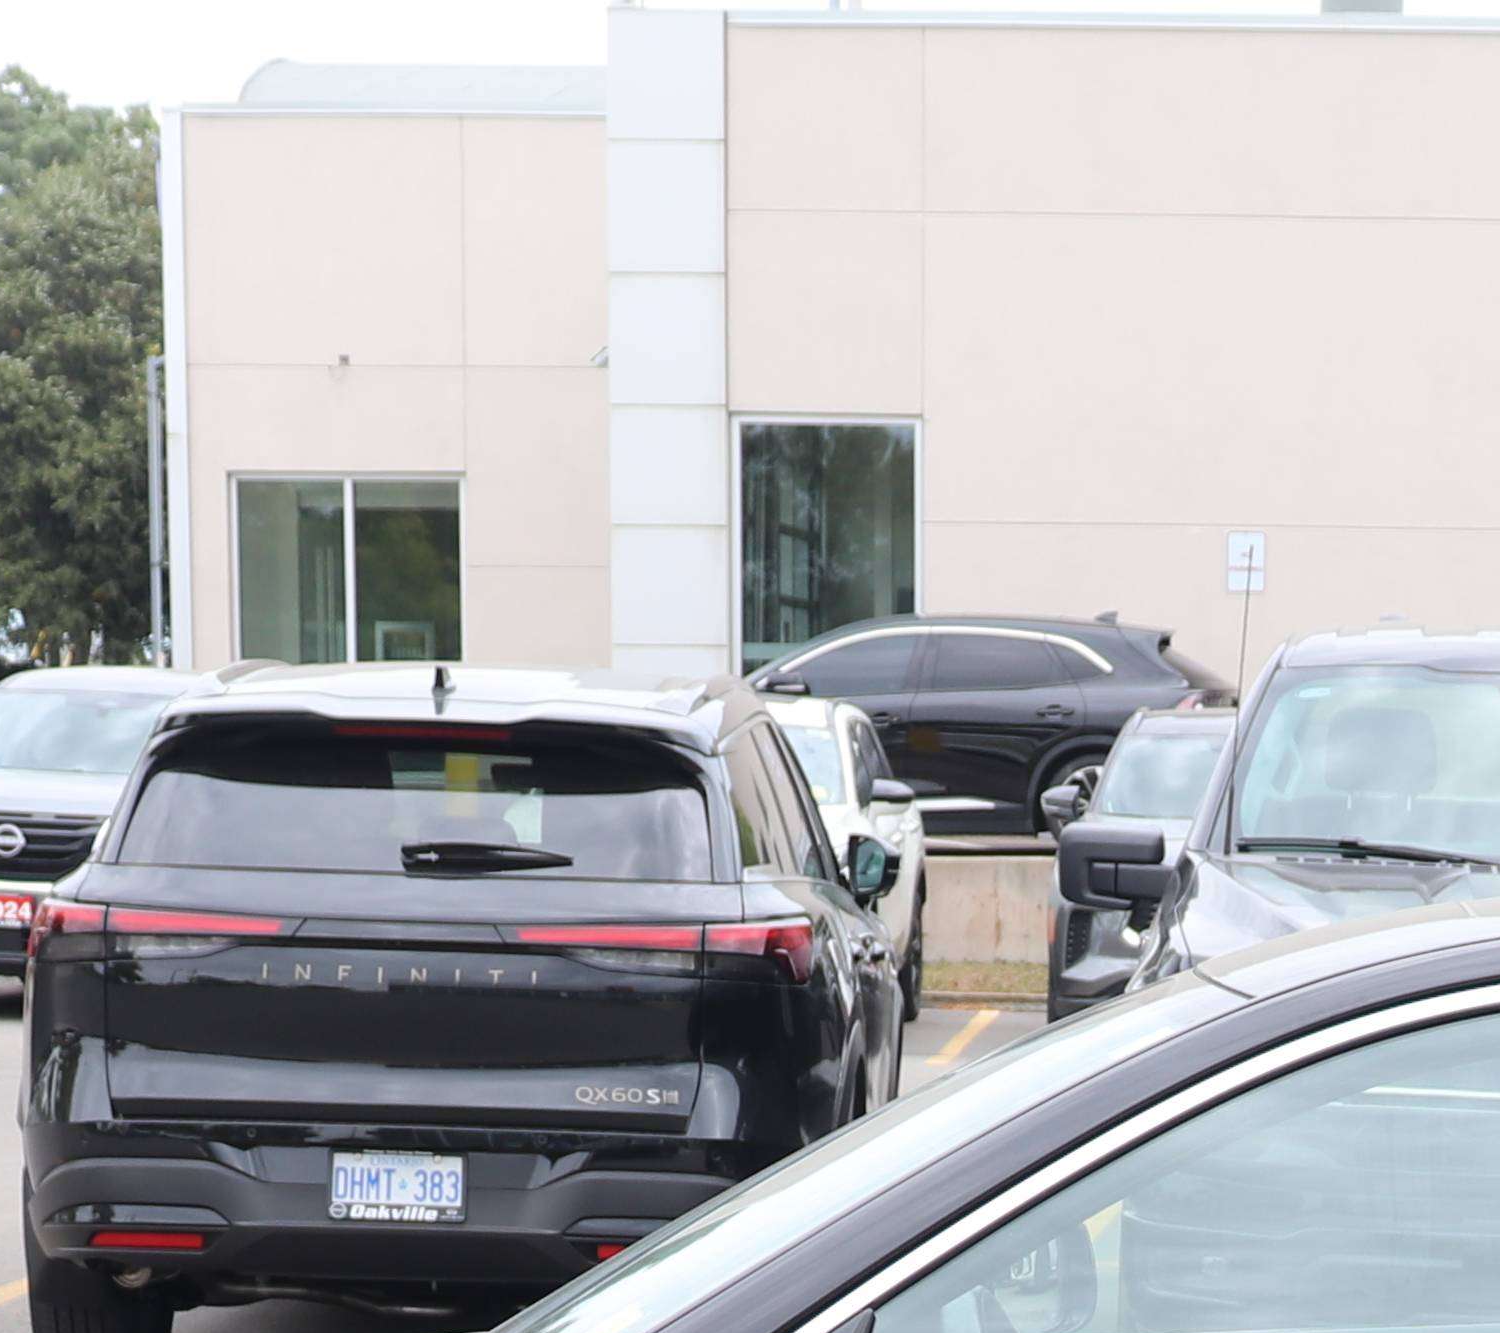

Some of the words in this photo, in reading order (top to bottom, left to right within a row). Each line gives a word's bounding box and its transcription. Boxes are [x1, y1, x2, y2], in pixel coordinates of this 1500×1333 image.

[262, 962, 536, 985] INFINITI
[334, 1165, 396, 1201] DHMT
[413, 1168, 460, 1203] 383
[349, 1203, 439, 1222] Oakville
